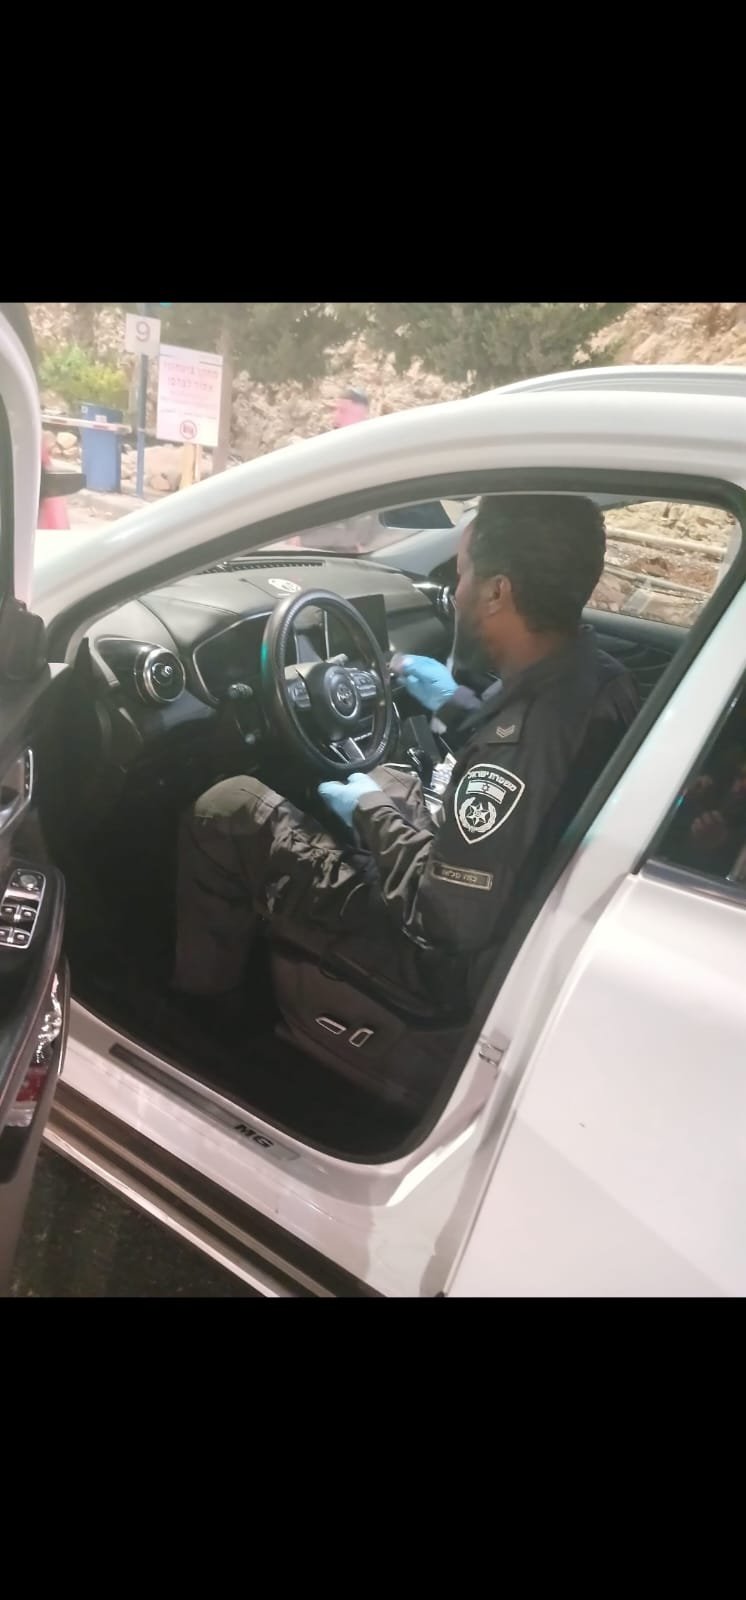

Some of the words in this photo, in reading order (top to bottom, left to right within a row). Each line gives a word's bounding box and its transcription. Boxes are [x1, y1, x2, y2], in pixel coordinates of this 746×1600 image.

[136, 321, 151, 342] 9
[468, 770, 489, 779] ישראל
[488, 772, 517, 791] משטרת
[234, 1124, 275, 1148] MG
